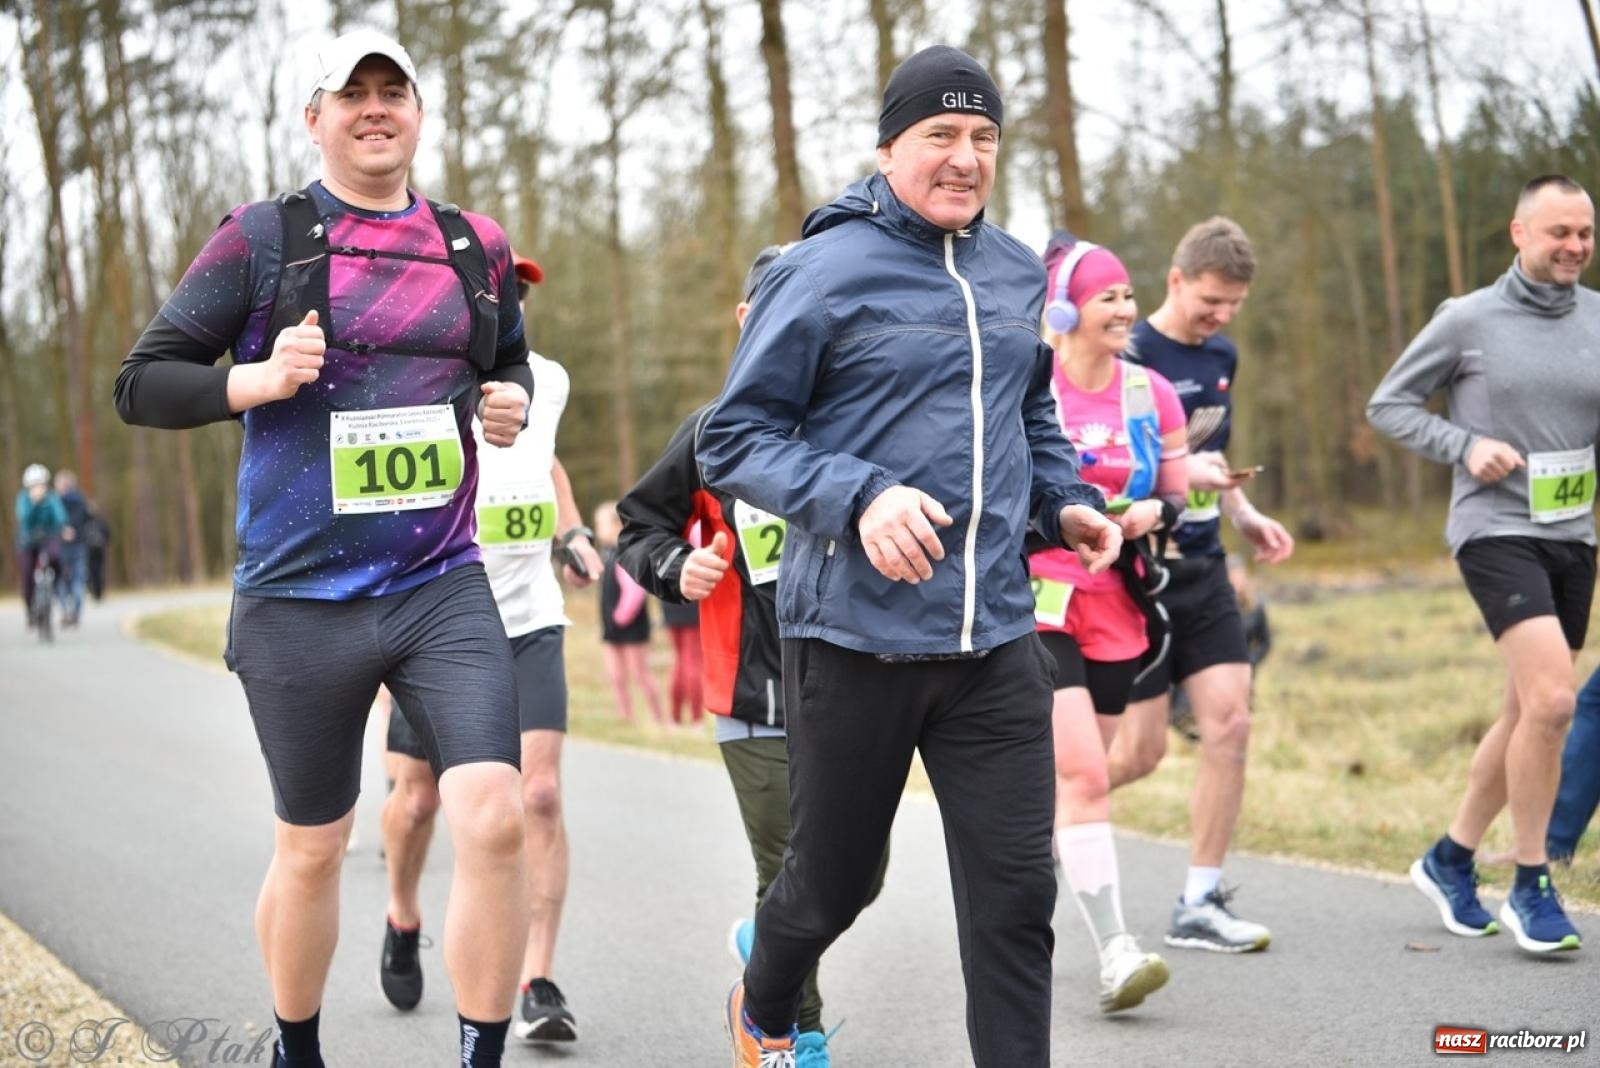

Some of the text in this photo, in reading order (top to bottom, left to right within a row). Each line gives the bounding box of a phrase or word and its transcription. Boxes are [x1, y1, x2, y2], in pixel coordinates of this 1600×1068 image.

[355, 443, 447, 494] 101
[1554, 474, 1585, 506] 44
[505, 505, 543, 539] 89
